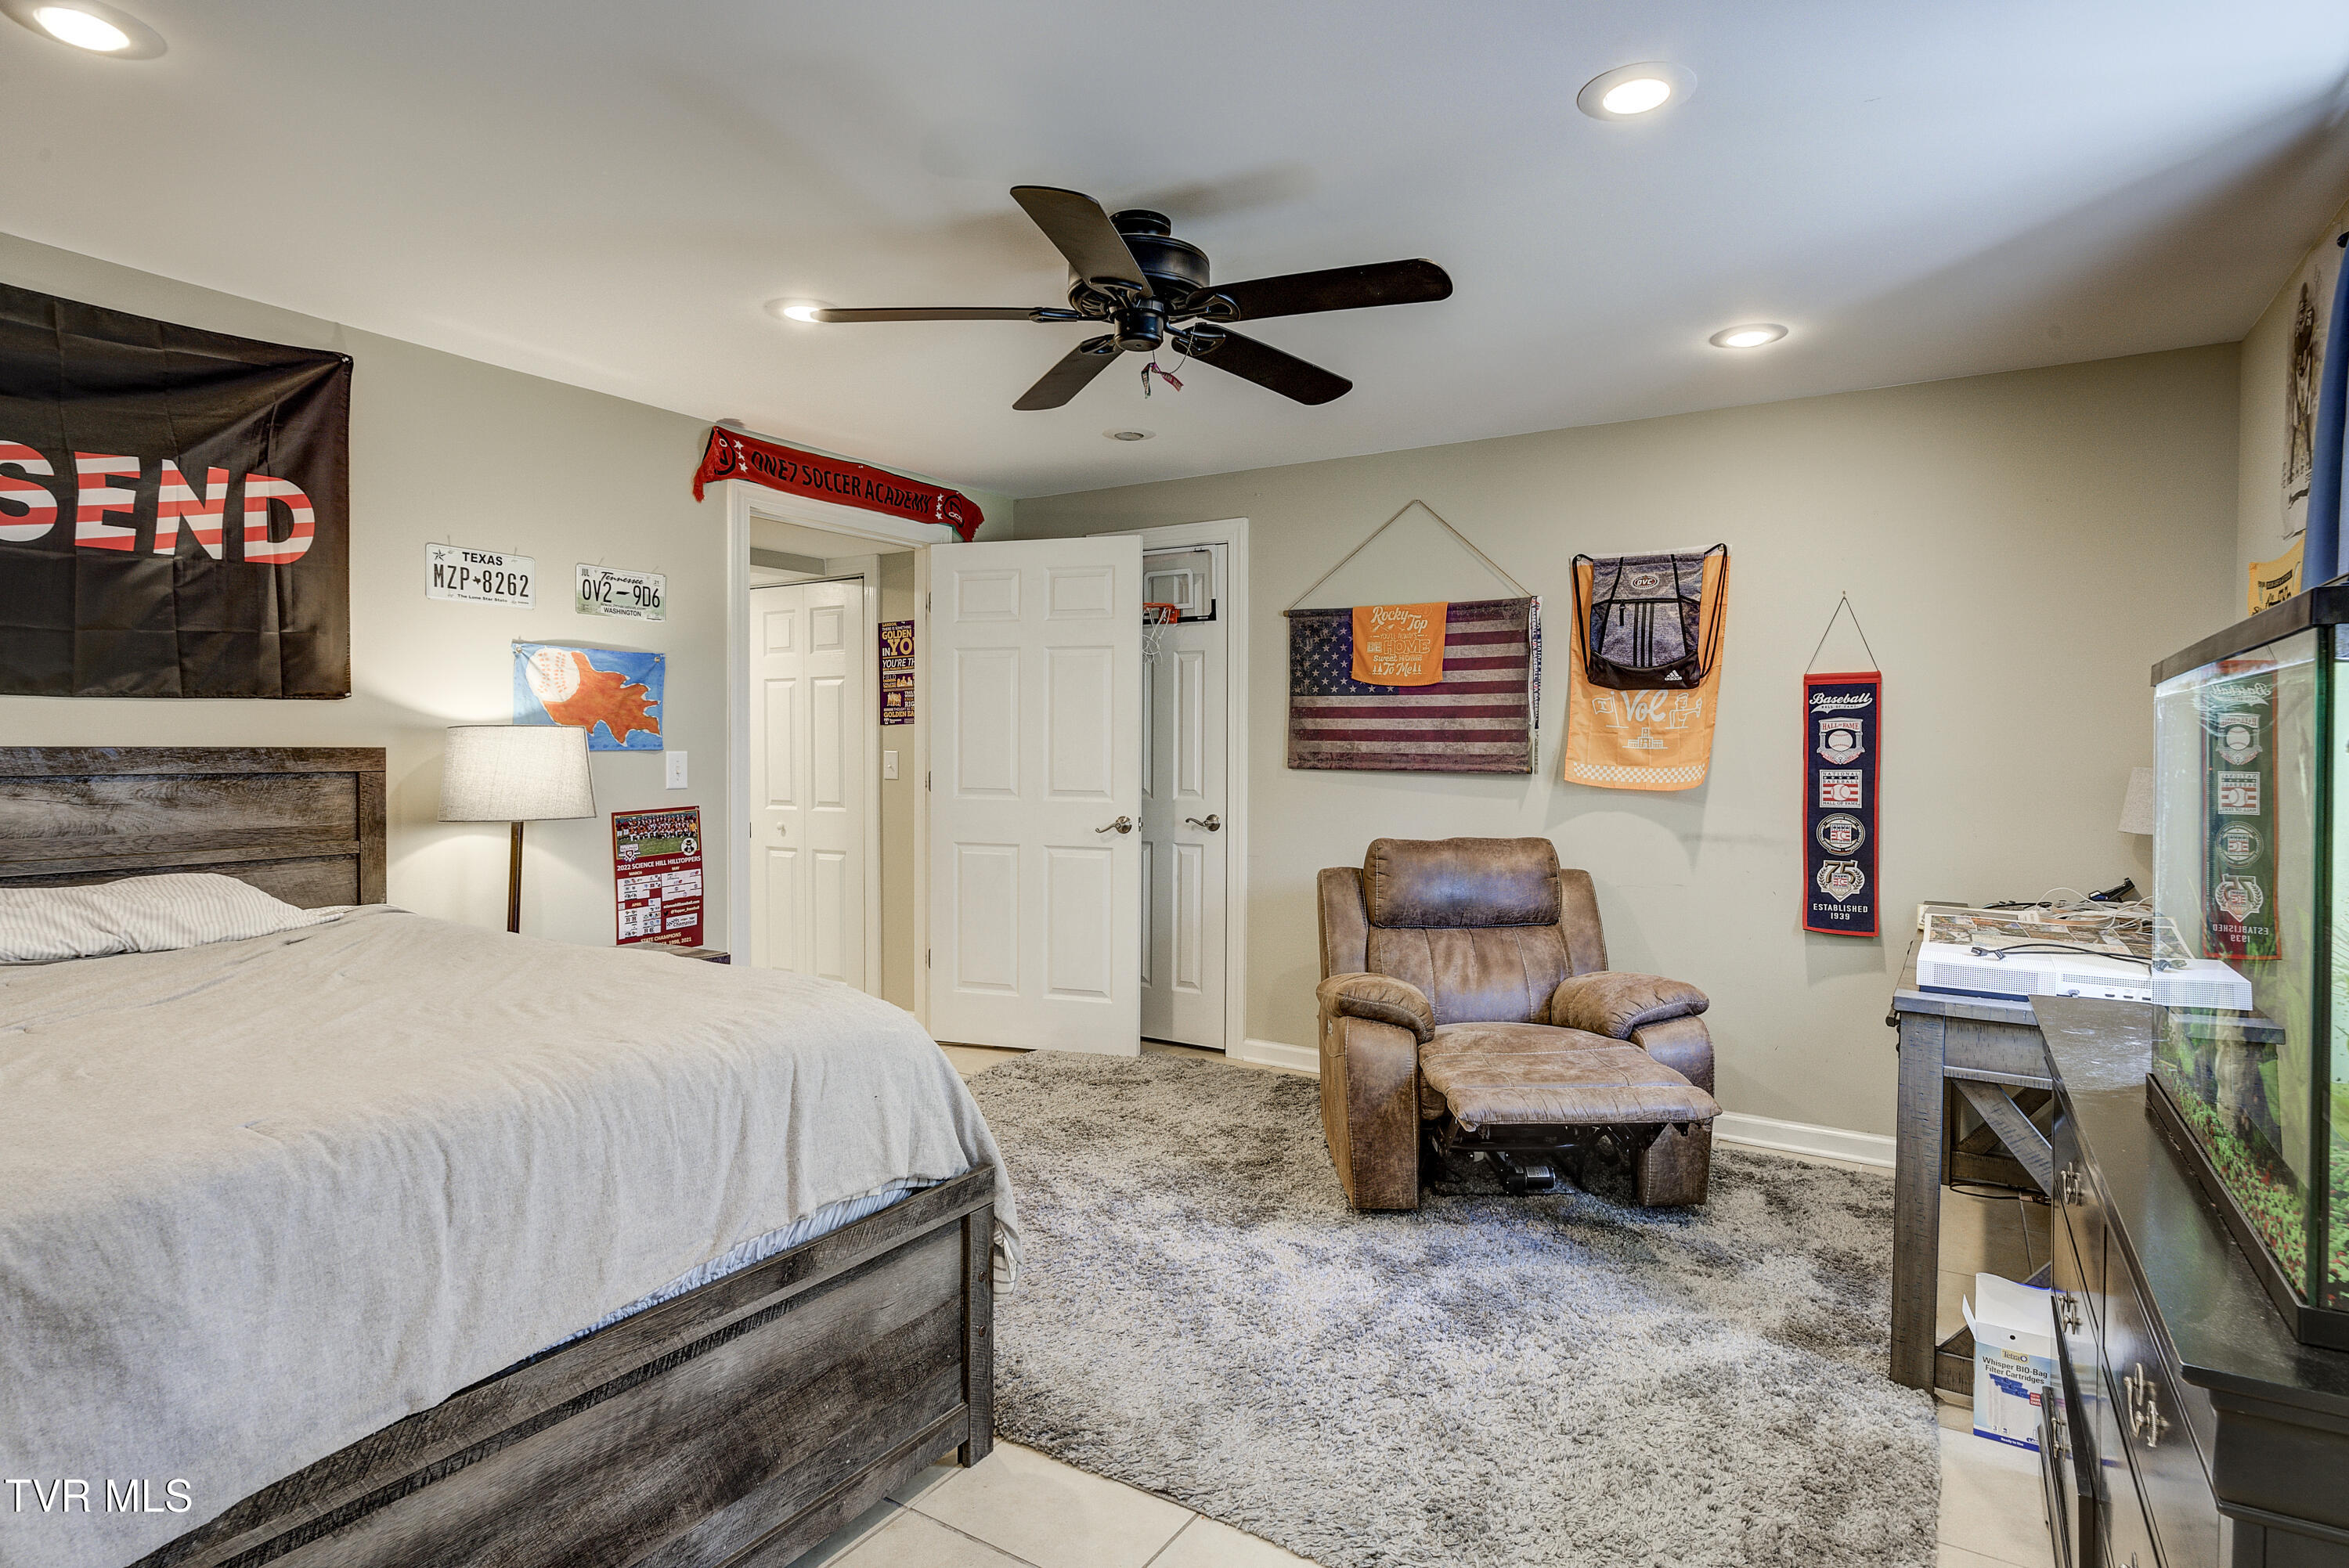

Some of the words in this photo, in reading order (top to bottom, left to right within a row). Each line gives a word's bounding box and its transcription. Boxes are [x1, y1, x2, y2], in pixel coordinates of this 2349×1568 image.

[751, 450, 798, 483] ONE7
[802, 465, 862, 498] SOCCER
[864, 480, 933, 514] ACADEMY
[0, 440, 315, 564] SEND
[462, 551, 503, 566] TEXAS
[581, 568, 590, 577] JUL
[601, 571, 644, 585] Tennessee
[604, 607, 642, 617] WASHINGTON
[1370, 606, 1409, 625] Rocky
[1406, 613, 1428, 633] Top
[882, 629, 912, 640] GOLDEN
[882, 647, 890, 656] IN
[887, 636, 915, 656] YO
[1366, 640, 1383, 653] BE
[1384, 639, 1431, 655] HOME
[882, 658, 907, 668] YOU'RE
[1383, 661, 1395, 676] To
[1395, 662, 1413, 677] Me
[1619, 689, 1669, 722] Vol
[1809, 692, 1873, 705] Baseball
[632, 860, 655, 870] SCIENCE
[667, 856, 701, 865] HILLTOPPERS
[1825, 861, 1856, 885] 75
[1813, 903, 1868, 913] ESTABLISHED
[1831, 912, 1850, 921] 1939
[654, 932, 682, 941] CHAMPIONS
[2003, 1350, 2020, 1361] Tetra
[1983, 1355, 2015, 1370] Whisper
[2015, 1364, 2048, 1379] BIO-Bag
[1985, 1364, 2004, 1375] Filter
[2005, 1369, 2044, 1384] Cartridges
